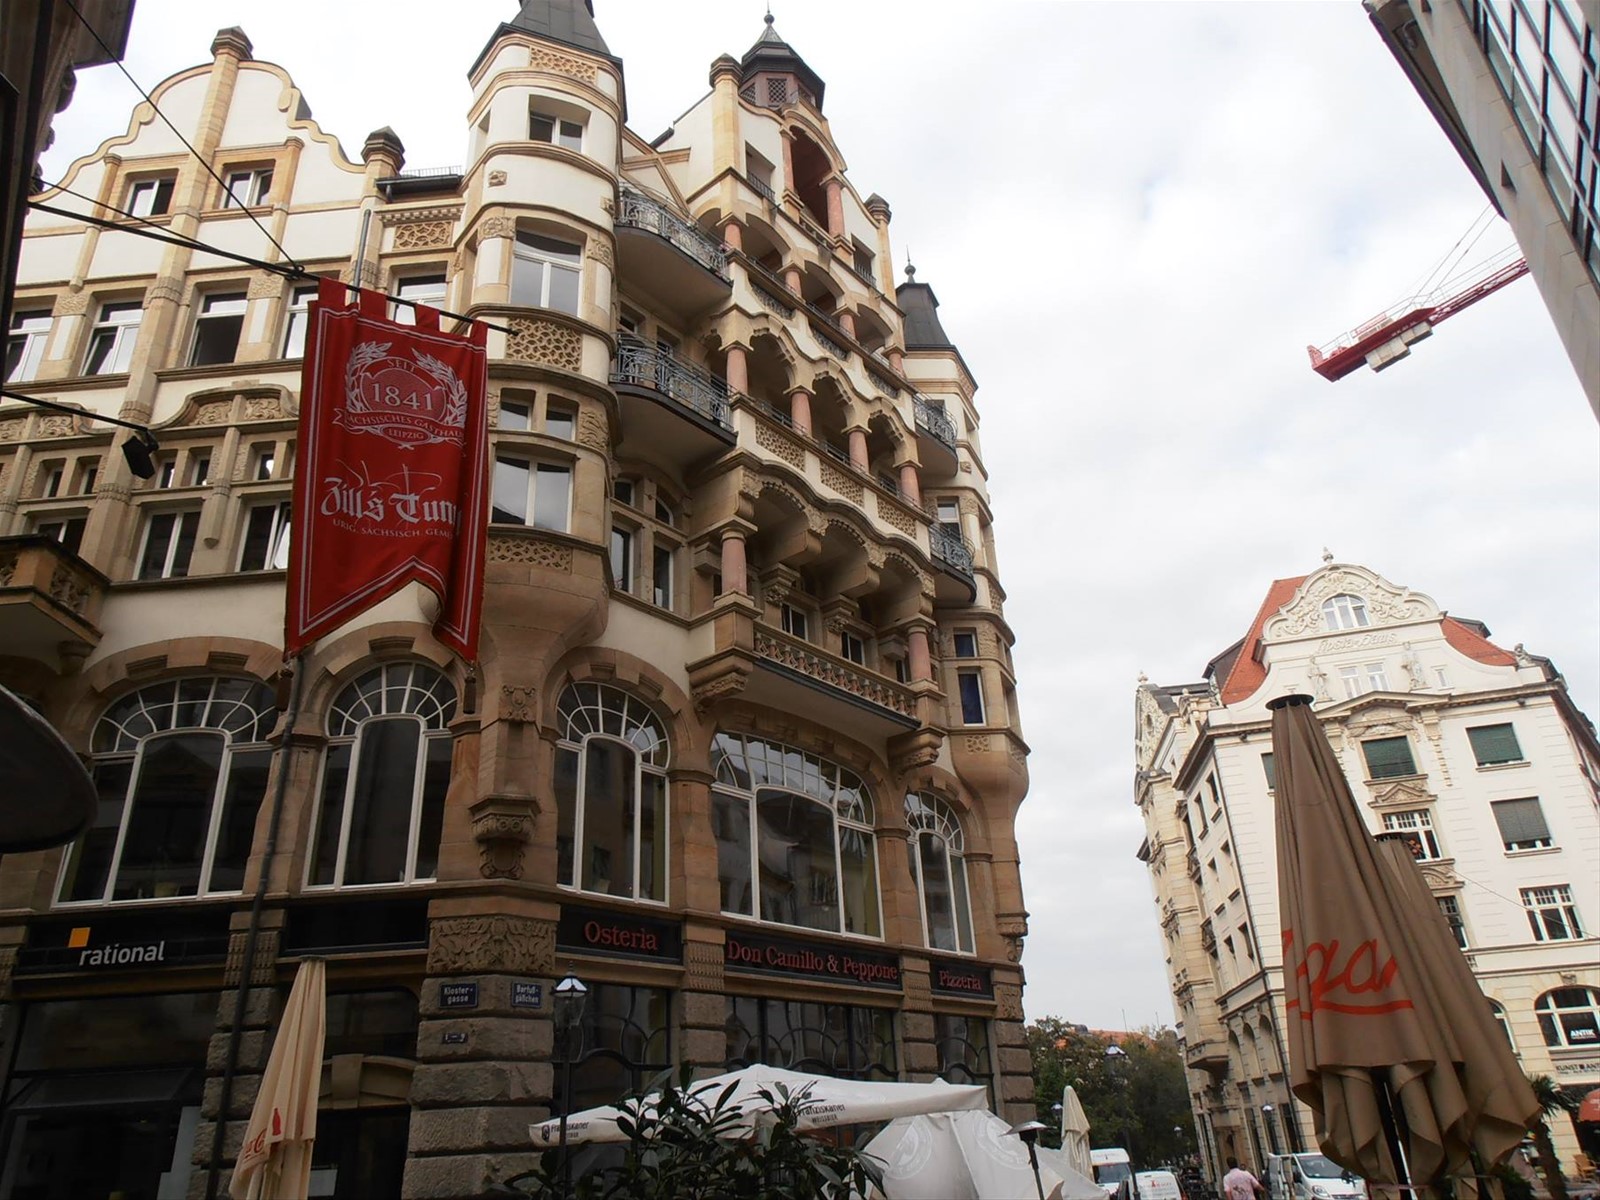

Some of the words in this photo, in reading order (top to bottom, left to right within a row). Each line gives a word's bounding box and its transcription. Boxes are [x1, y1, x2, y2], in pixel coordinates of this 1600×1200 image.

[386, 358, 416, 373] SEIT
[372, 383, 433, 411] 1841
[388, 428, 425, 440] LEIPZIG
[413, 418, 462, 437] GASTHAU
[584, 921, 658, 951] Osteria
[79, 940, 165, 967] rational
[727, 941, 762, 964] Don
[766, 947, 824, 972] Camillo
[827, 954, 839, 974] &
[843, 956, 898, 983] Peppone
[939, 970, 982, 991] Pizzeria
[447, 995, 469, 1005] gasse
[800, 1104, 846, 1116] ranziskaner
[550, 1122, 590, 1133] Fraiskaner
